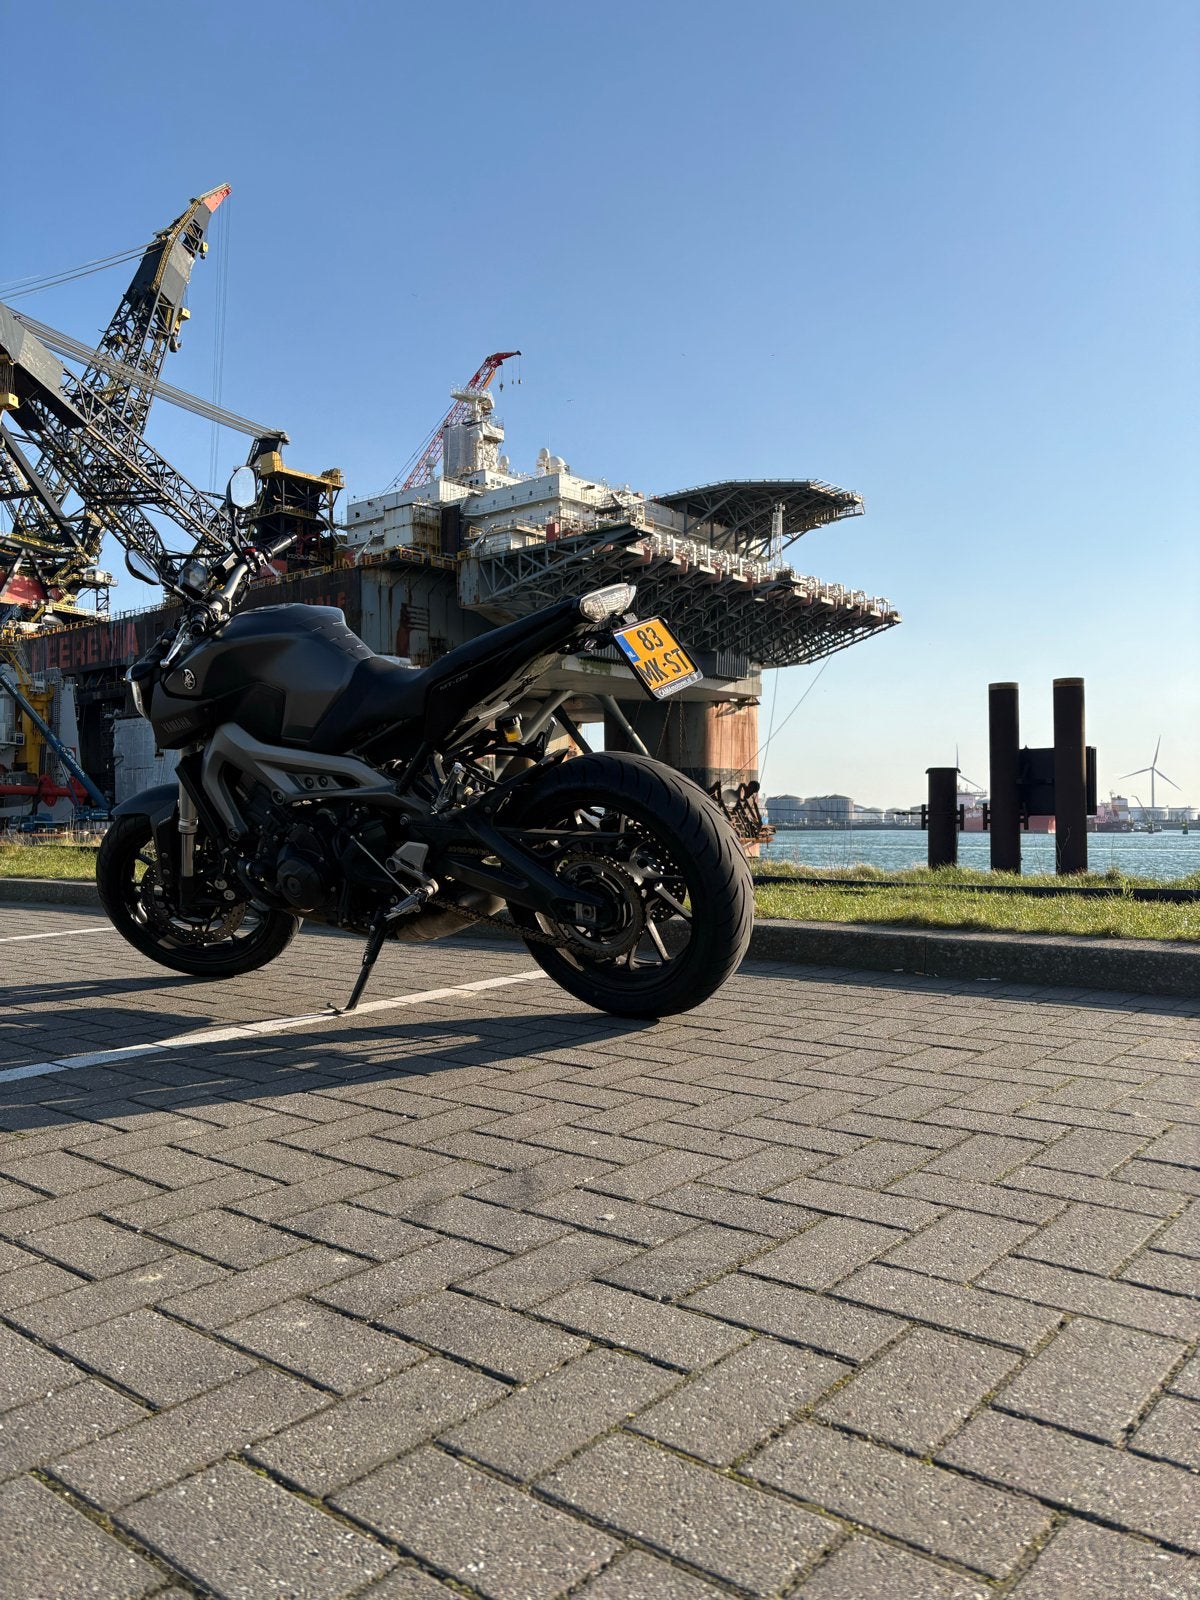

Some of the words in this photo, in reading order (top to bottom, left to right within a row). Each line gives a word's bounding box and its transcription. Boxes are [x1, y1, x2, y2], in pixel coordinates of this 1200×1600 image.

[636, 627, 663, 651] 83
[635, 648, 689, 686] MK-ST
[160, 717, 193, 734] YAMAHA
